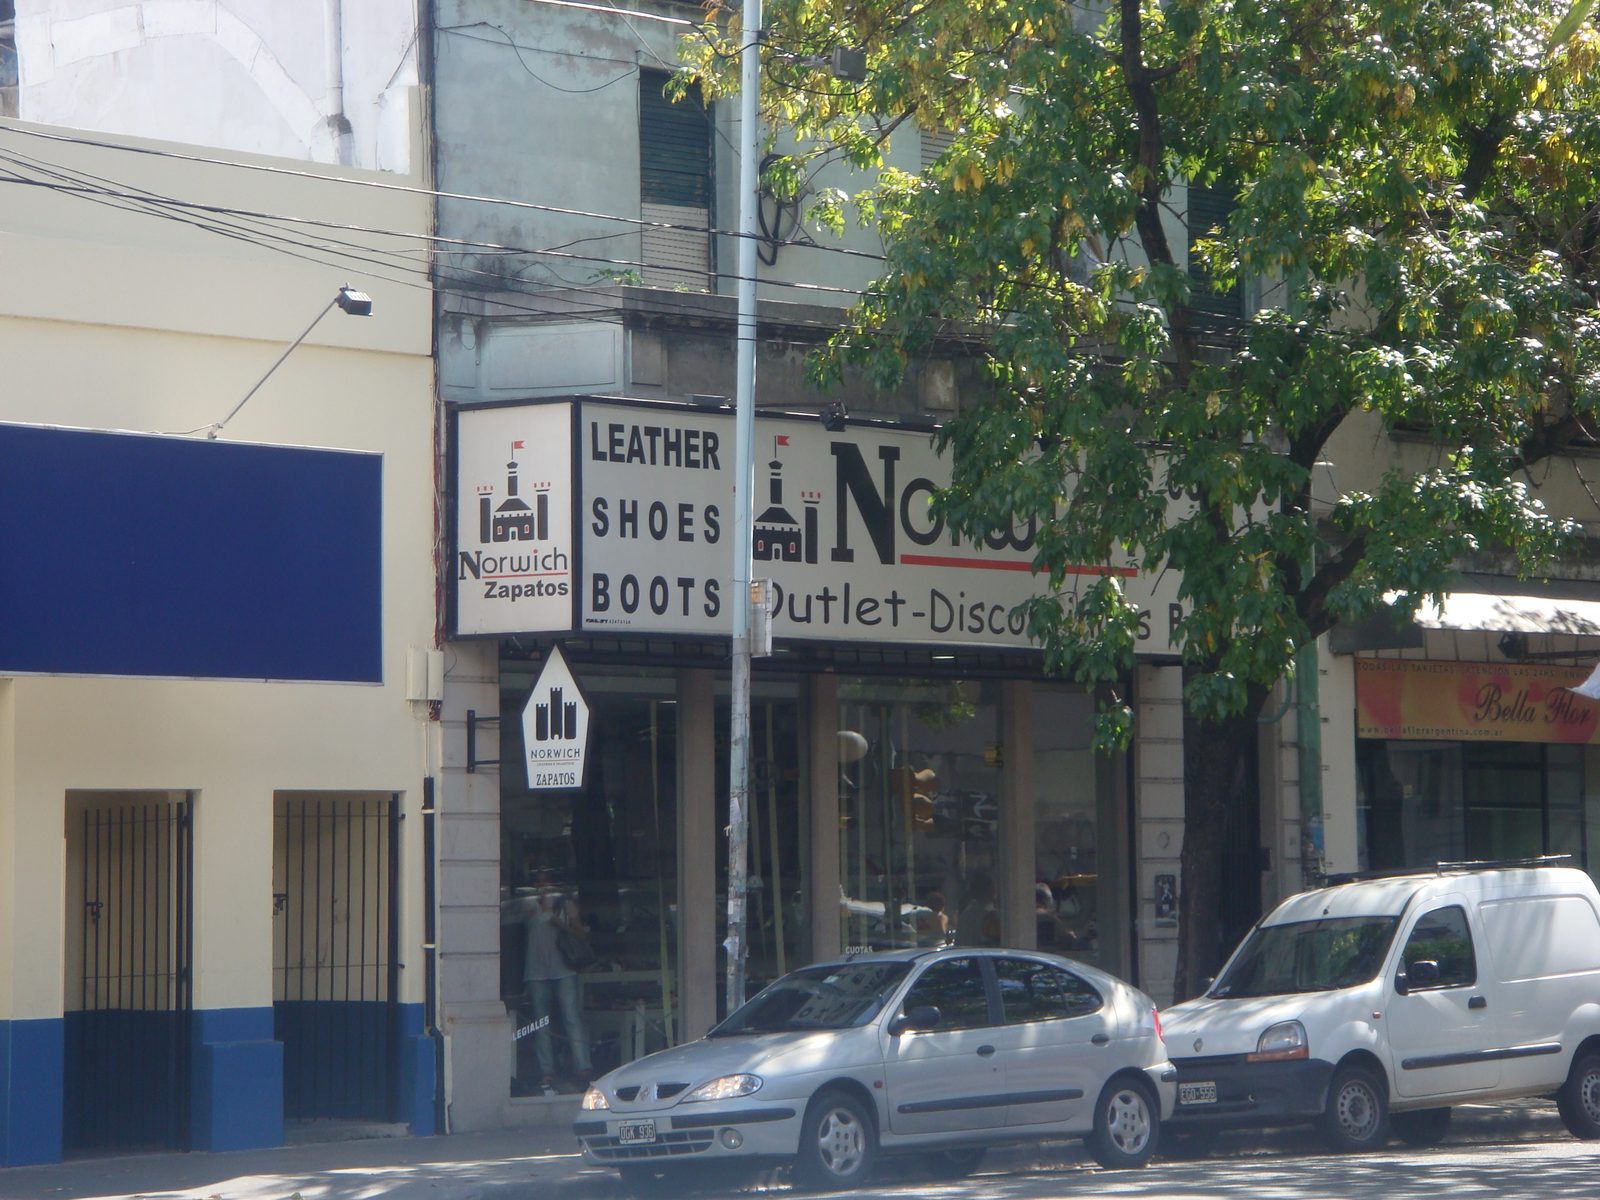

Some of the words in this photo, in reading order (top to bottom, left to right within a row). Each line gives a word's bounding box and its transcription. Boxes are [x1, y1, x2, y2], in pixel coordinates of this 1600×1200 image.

[591, 421, 721, 470] LEATHER
[592, 496, 721, 544] SHOES
[459, 547, 568, 580] Norwich
[484, 579, 569, 602] Zapatos
[592, 573, 721, 618] BOOTS
[1474, 682, 1536, 723] Bella
[1543, 686, 1591, 725] Flor
[531, 748, 580, 760] NORWICH
[536, 772, 576, 786] ZAPATOS
